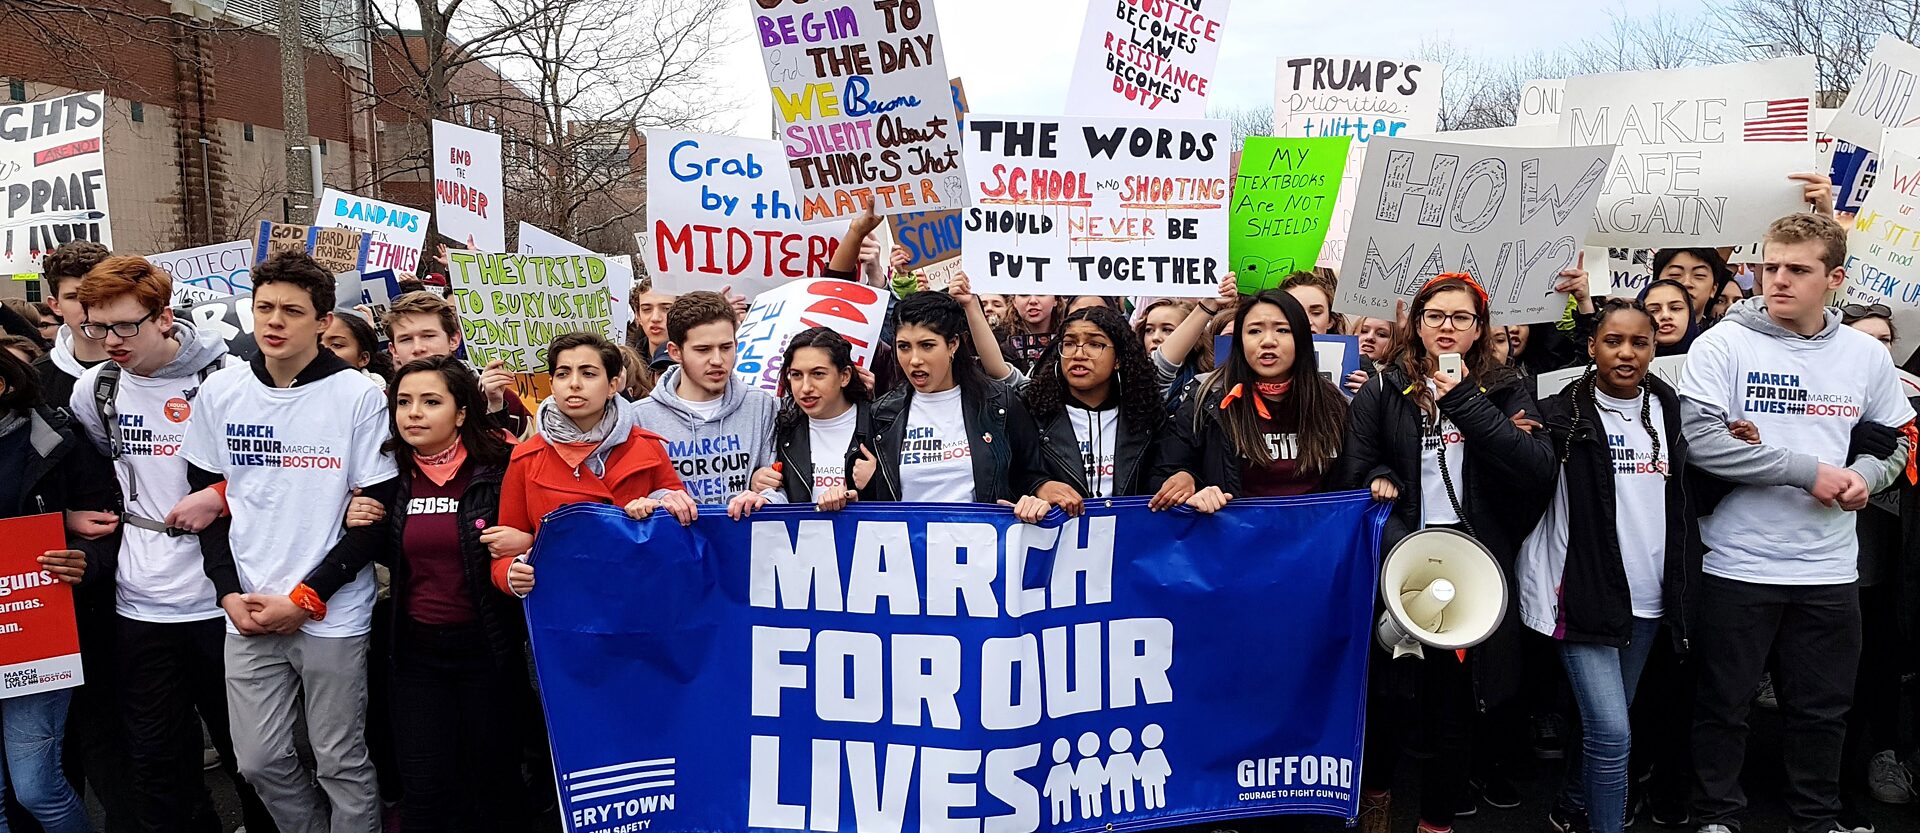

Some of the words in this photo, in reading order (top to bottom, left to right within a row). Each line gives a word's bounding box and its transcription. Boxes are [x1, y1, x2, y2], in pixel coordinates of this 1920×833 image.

[874, 0, 922, 33] TO
[1117, 0, 1198, 54] BECOMES
[806, 43, 874, 78] THE
[878, 34, 934, 74] DAY
[1104, 31, 1208, 97] RESISTANCE
[1106, 52, 1182, 104] BECOMES
[1287, 57, 1422, 96] TRUMP'S
[772, 83, 840, 123] WE
[843, 76, 921, 117] Become
[1112, 75, 1163, 110] DUTY
[1282, 93, 1409, 122] priorities:
[1523, 85, 1566, 116] ONL
[0, 91, 102, 142] GHTS
[1570, 98, 1727, 146] MAKE
[786, 119, 873, 158] SILENT
[970, 120, 1059, 159] THE
[1082, 126, 1218, 162] WORDS
[450, 147, 472, 167] END
[669, 140, 763, 182] Grab
[789, 150, 903, 189] THINGS
[908, 144, 959, 175] That
[1268, 148, 1310, 171] MY
[456, 167, 466, 179] THE
[980, 164, 1093, 201] SCHOOL
[1096, 178, 1120, 191] AND
[1119, 174, 1225, 202] SHOOTING
[1238, 173, 1326, 191] TEXTBOOKS
[1600, 151, 1702, 196] AFE
[436, 178, 489, 219] MURDER
[702, 185, 740, 217] by
[751, 190, 801, 220] th
[801, 178, 941, 222] MATTER
[1236, 195, 1275, 213] Are
[1284, 195, 1326, 213] NOT
[1376, 150, 1608, 233] HOW
[271, 225, 304, 239] GOD
[316, 231, 344, 246] HEARD
[371, 230, 389, 243] FIX
[965, 207, 1053, 235] SHOULD
[1068, 216, 1155, 237] NEVER
[1168, 218, 1199, 239] BE
[1245, 217, 1320, 238] SHIELDS
[153, 246, 252, 281] ROTECT
[989, 251, 1050, 282] PUT
[1068, 256, 1219, 285] TOGETHER
[1855, 263, 1901, 298] SPEAK
[453, 288, 484, 315] TO
[490, 290, 545, 318] BURY
[1746, 386, 1776, 400] FOR
[1778, 388, 1808, 402] OUR
[1747, 372, 1800, 387] MARCH
[1744, 400, 1786, 414] LIVES
[1806, 404, 1860, 418] BOSTON
[1808, 394, 1842, 403] MARCH
[153, 434, 184, 443] MARC
[226, 423, 274, 439] MARCH
[227, 438, 252, 452] FOR
[254, 440, 282, 454] OUR
[669, 434, 741, 458] MARCH
[282, 446, 316, 454] MARCH
[318, 446, 330, 454] 24
[282, 456, 341, 469] BOSTON
[712, 453, 750, 473] OUR
[749, 515, 1117, 618] MARCH
[0, 569, 59, 597] guns.
[4, 668, 37, 679] MARCH
[5, 680, 27, 689] LIVES
[21, 673, 38, 681] OUR
[39, 672, 72, 684] BOSTON
[752, 625, 961, 730] FOR
[980, 617, 1174, 730] OUR
[748, 734, 1042, 833] LIVES
[1237, 755, 1353, 788] GIFFORD
[1238, 790, 1277, 801] COURAGE
[1277, 789, 1288, 798] TO
[1290, 789, 1314, 797] FIGHT
[1316, 789, 1334, 798] GUN
[572, 794, 675, 828] ERYTOWN
